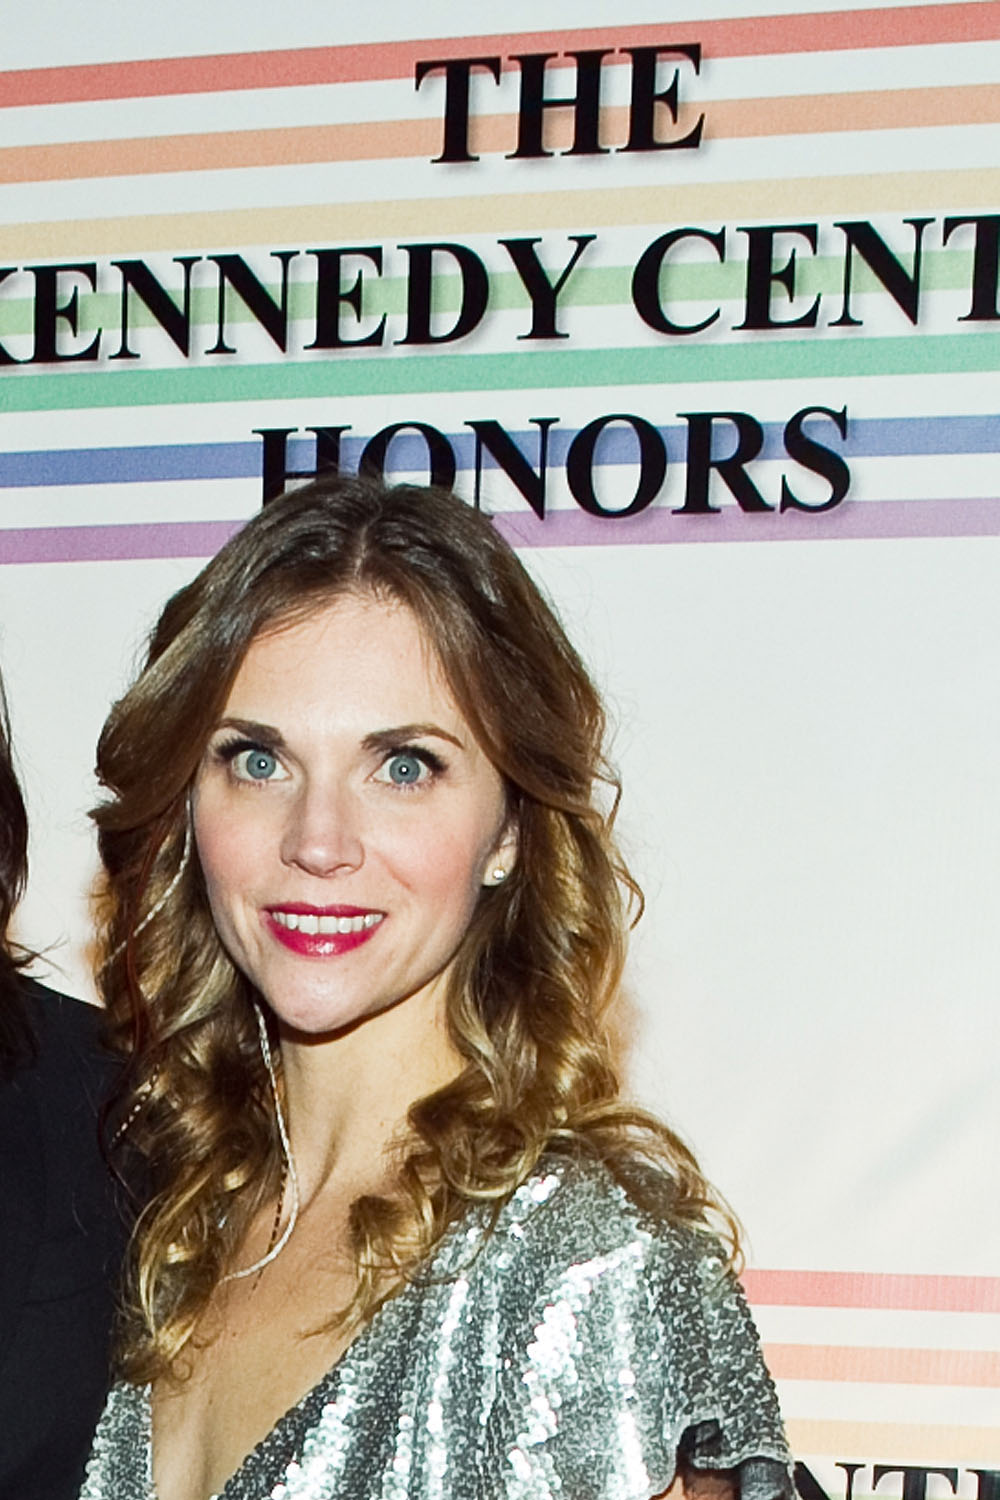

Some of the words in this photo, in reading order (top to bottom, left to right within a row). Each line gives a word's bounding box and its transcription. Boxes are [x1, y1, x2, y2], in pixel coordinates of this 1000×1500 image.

[414, 43, 706, 164] THE
[631, 213, 1000, 336] CENT
[251, 404, 852, 521] HONORS
